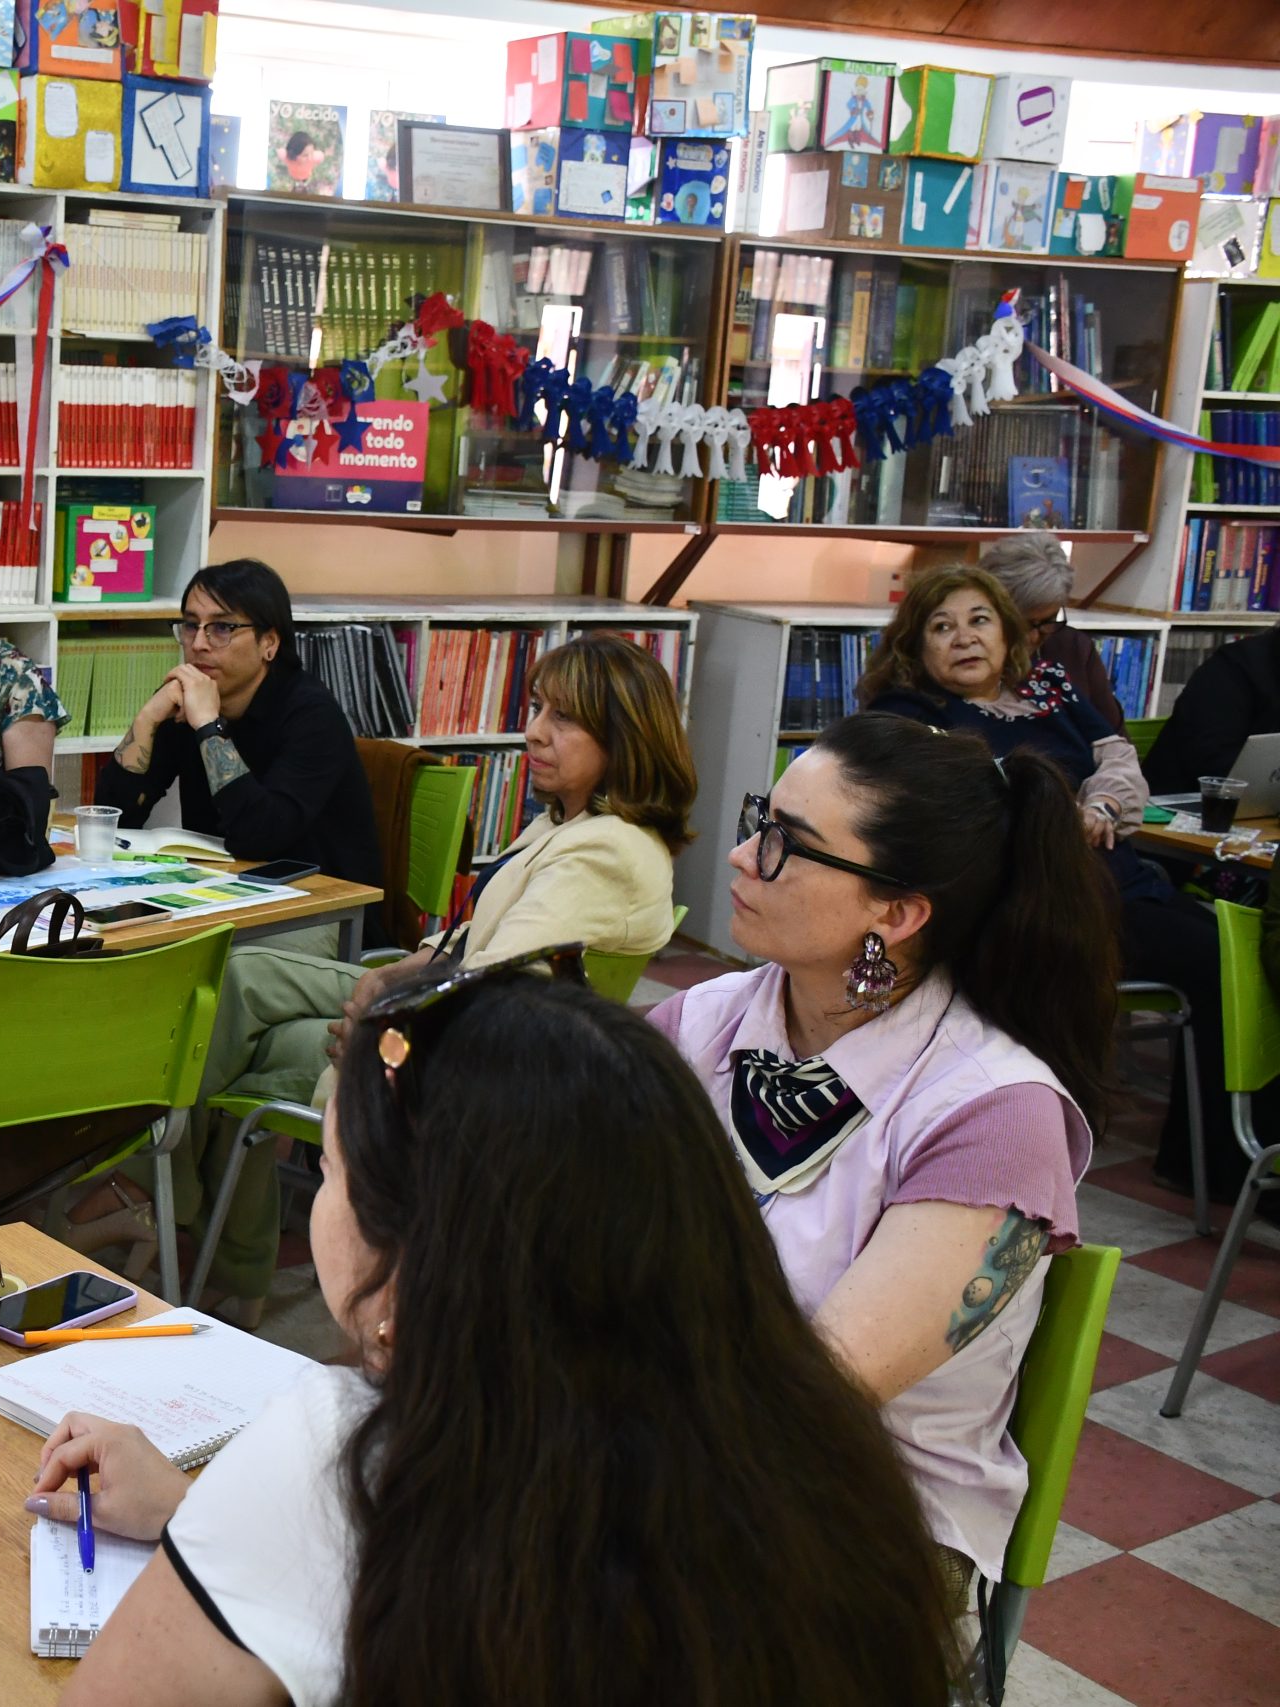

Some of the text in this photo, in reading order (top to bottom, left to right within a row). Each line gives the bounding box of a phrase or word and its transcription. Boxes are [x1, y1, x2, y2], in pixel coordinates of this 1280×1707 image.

[295, 106, 339, 122] decido
[752, 130, 766, 193] Arte moderno
[738, 151, 748, 193] moderno
[357, 414, 414, 432] endo
[366, 432, 405, 450] todo
[339, 452, 418, 469] momento
